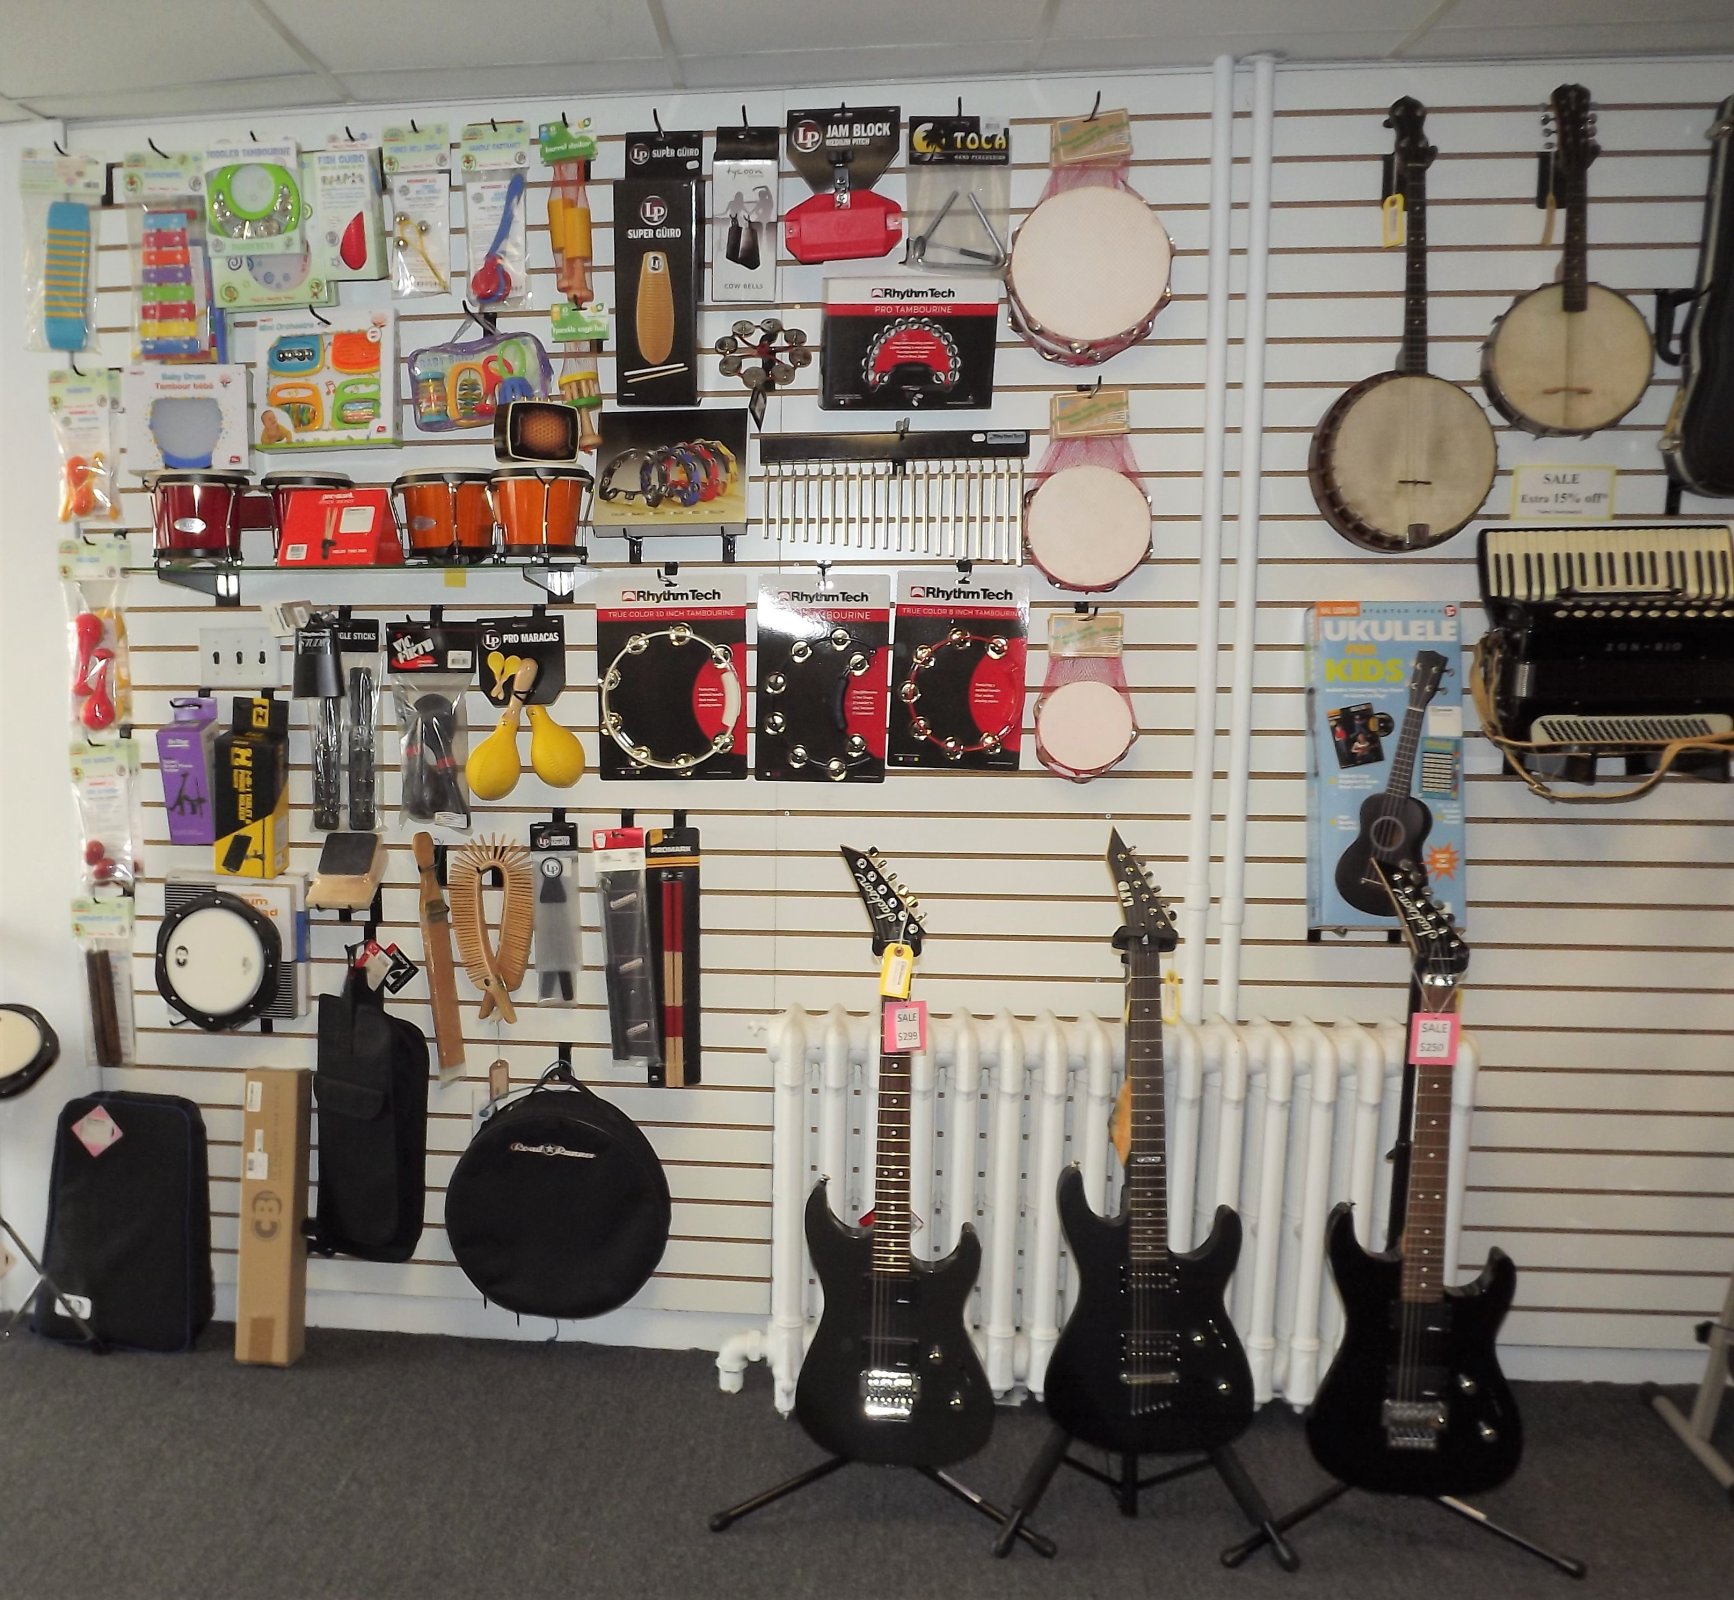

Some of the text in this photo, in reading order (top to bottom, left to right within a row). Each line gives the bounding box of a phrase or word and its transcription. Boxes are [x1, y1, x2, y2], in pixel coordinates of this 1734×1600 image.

[826, 124, 849, 137] JAM
[853, 122, 890, 137] BLOCK
[953, 132, 1006, 149] TOCA
[652, 149, 675, 158] SUPER
[627, 229, 654, 239] SUPER
[875, 305, 952, 313] PRO TAMBOURINE
[1543, 474, 1580, 484] SALE
[1521, 493, 1549, 503] Extra
[1554, 492, 1580, 503] 15%
[975, 609, 1021, 617] TAMBOURIN
[1324, 619, 1458, 641] UKULELE
[353, 632, 376, 640] STICKS
[502, 633, 519, 643] PRO
[521, 632, 559, 643] MARACAS
[1325, 658, 1404, 683] KIDS
[651, 845, 692, 853] PROMARK
[855, 872, 897, 922] Jackson
[1117, 881, 1135, 907] LTD
[1393, 888, 1438, 939] Jackson
[897, 1013, 917, 1022] SALE
[1421, 1022, 1448, 1033] SALE
